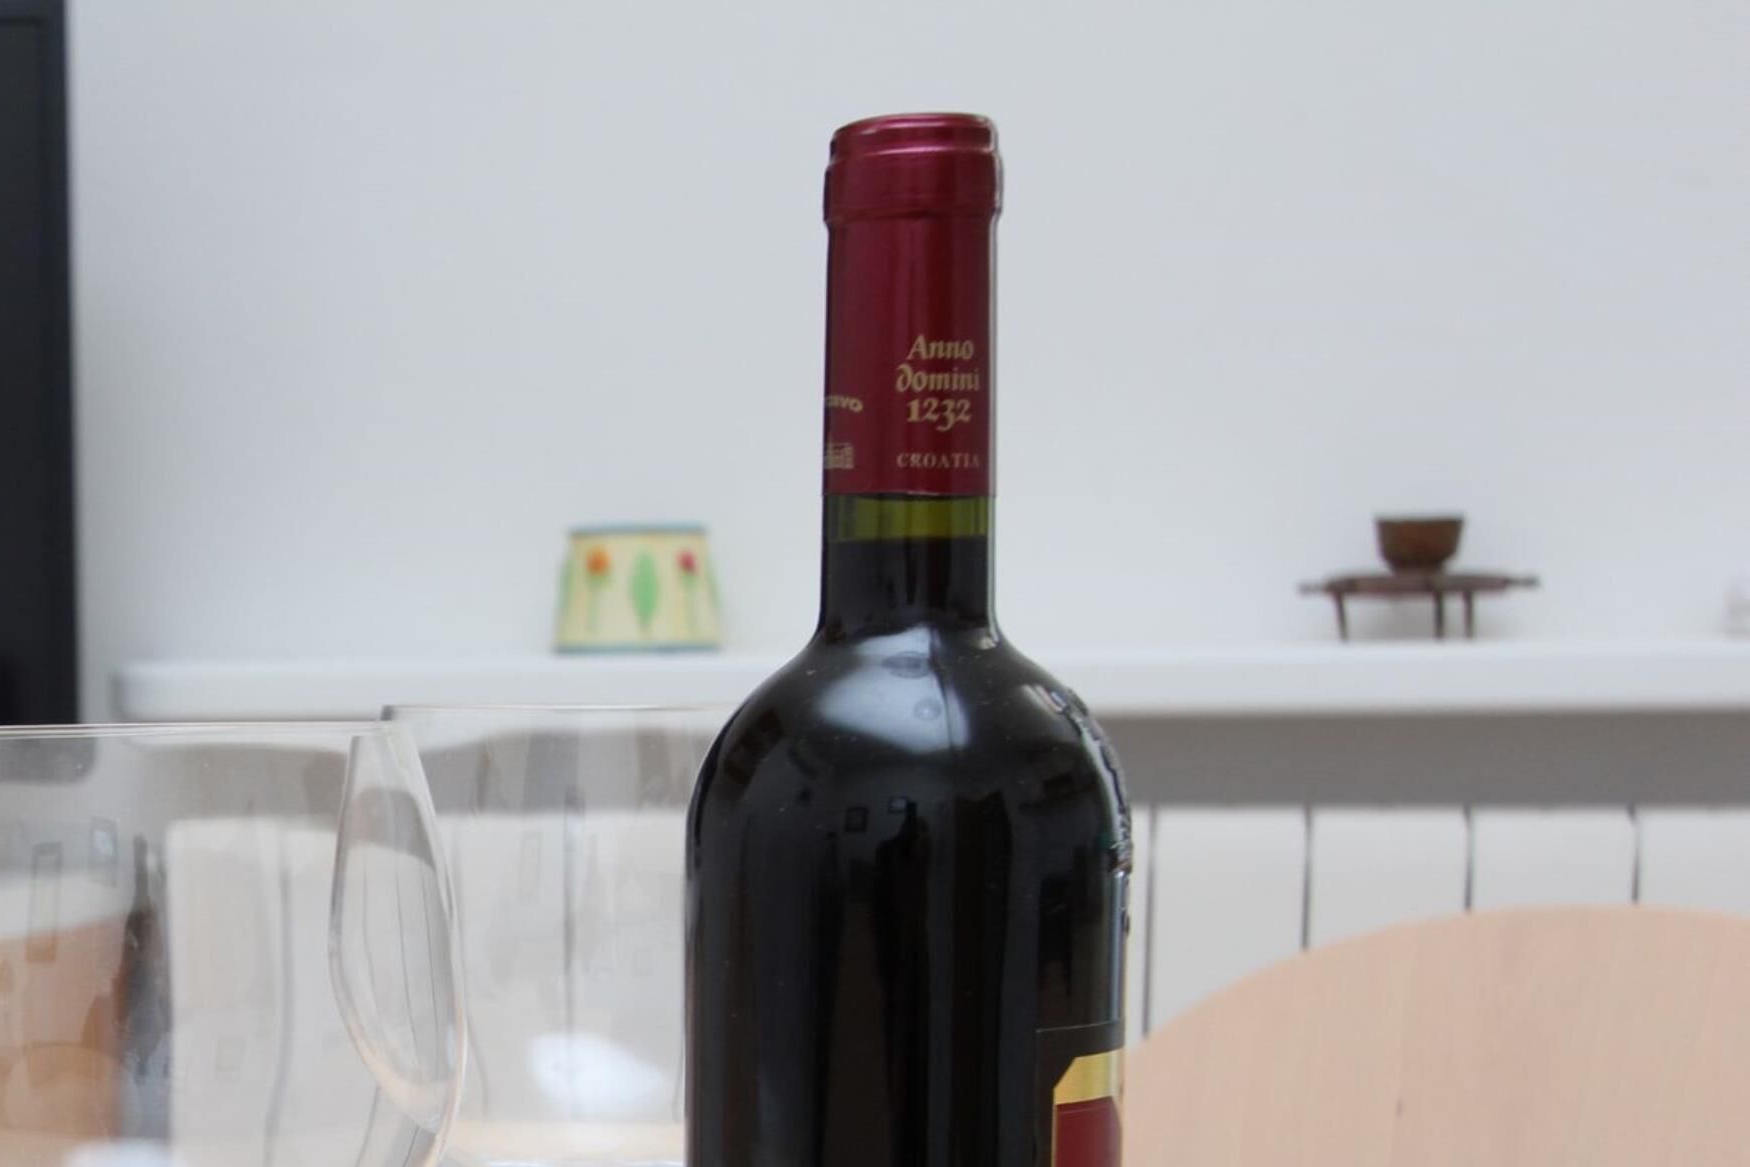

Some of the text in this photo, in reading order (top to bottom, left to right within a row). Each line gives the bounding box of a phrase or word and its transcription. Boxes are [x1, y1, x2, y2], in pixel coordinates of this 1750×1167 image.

[906, 333, 975, 361] Anno
[895, 362, 980, 393] domini
[906, 397, 972, 432] 1232
[897, 452, 981, 469] CROATIA
